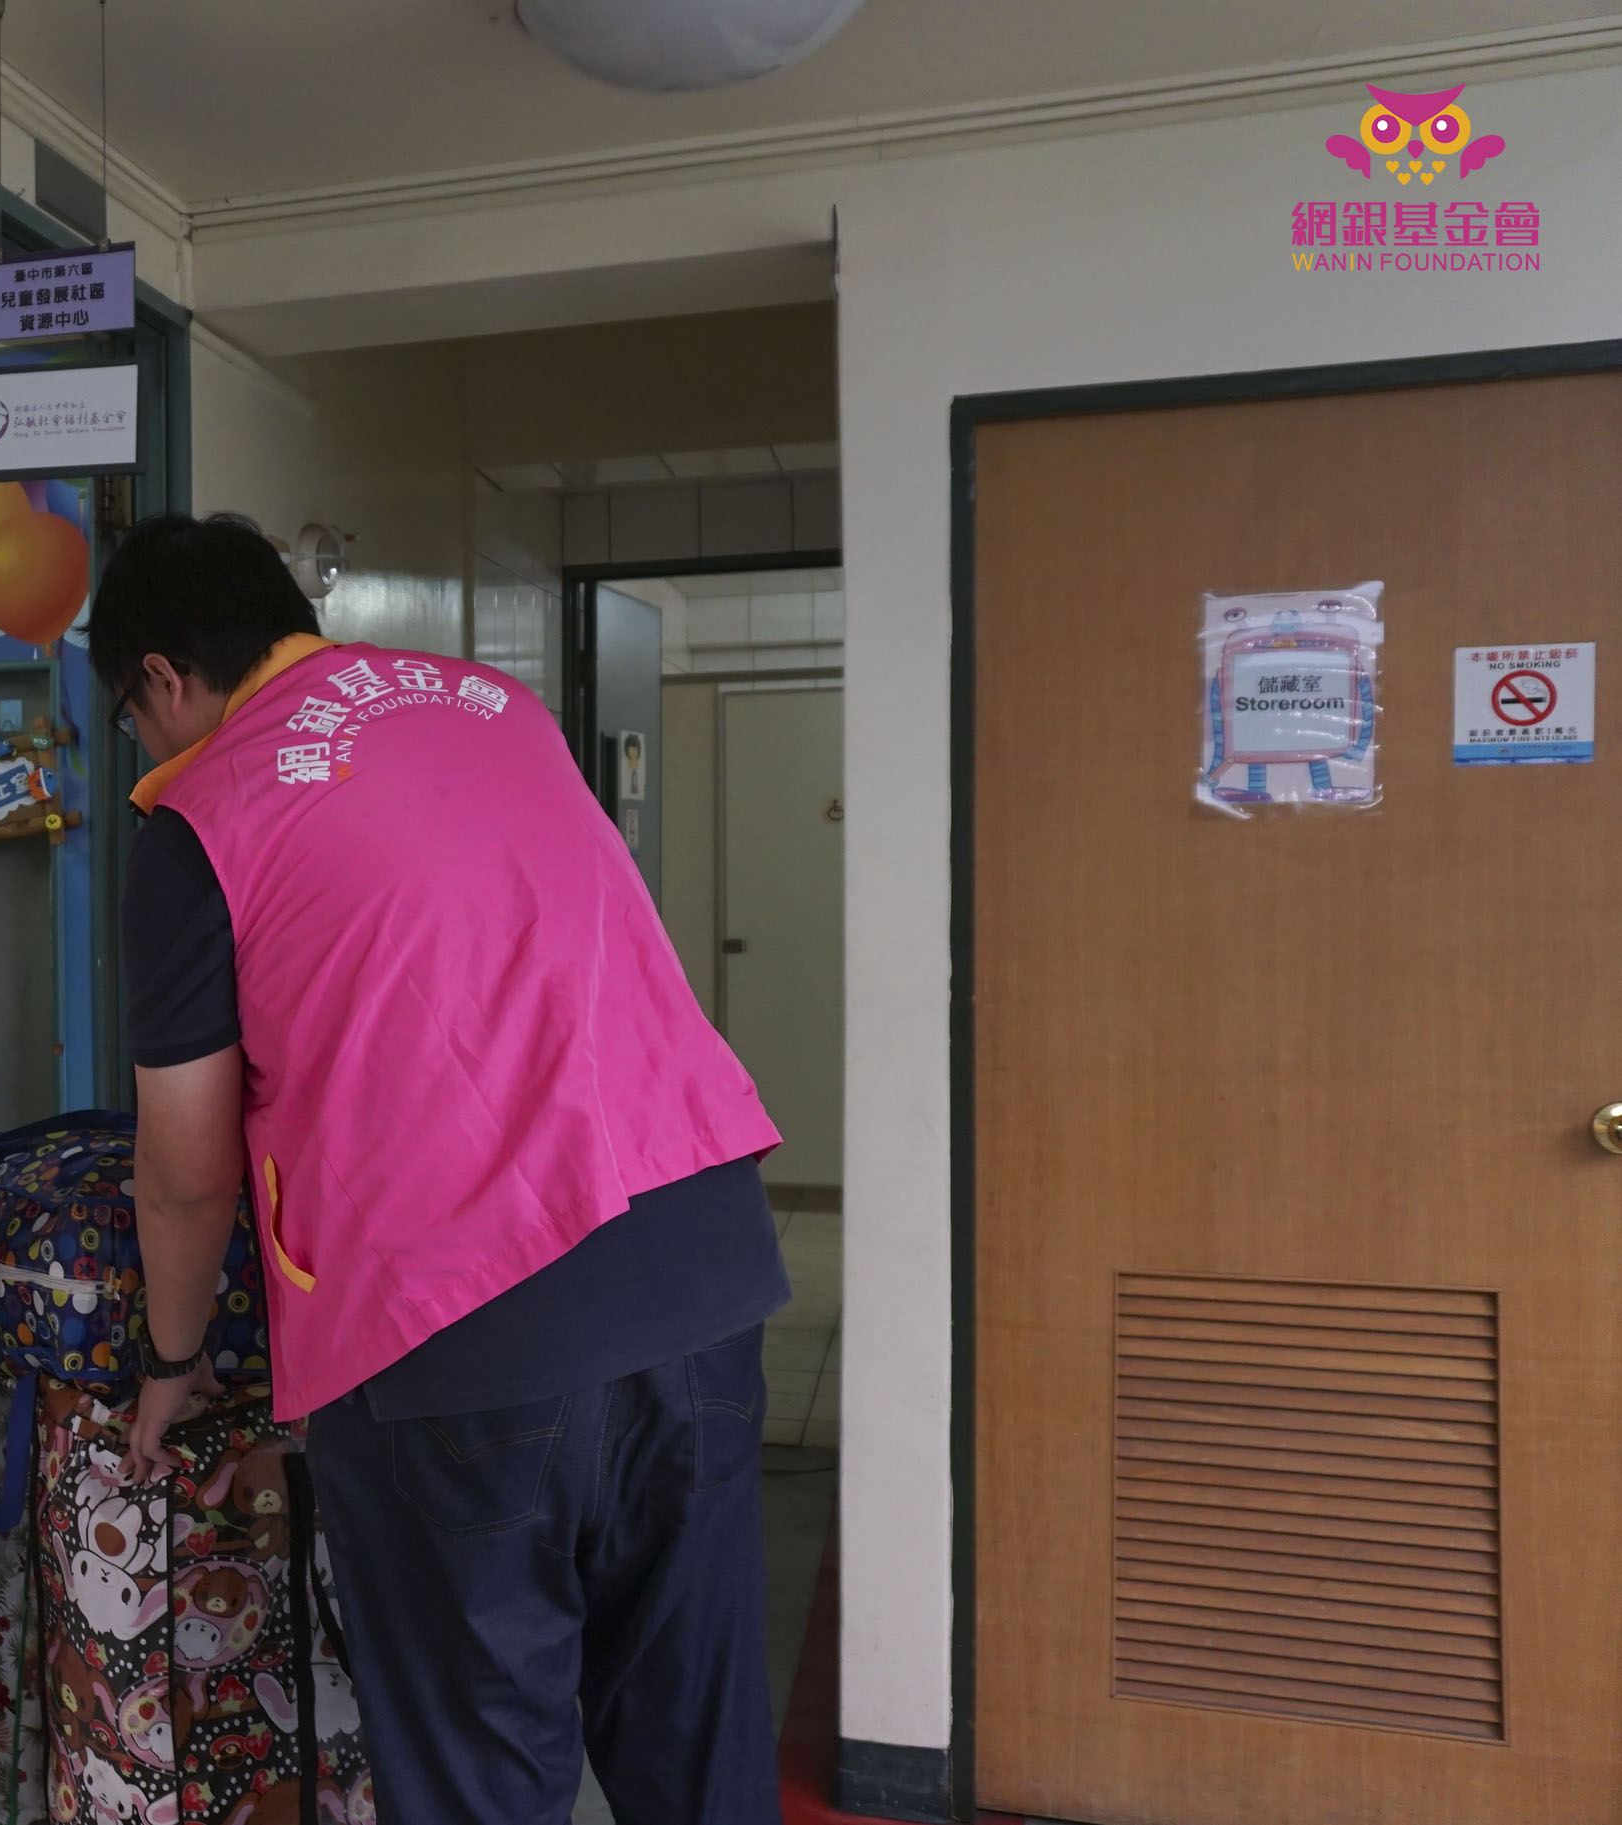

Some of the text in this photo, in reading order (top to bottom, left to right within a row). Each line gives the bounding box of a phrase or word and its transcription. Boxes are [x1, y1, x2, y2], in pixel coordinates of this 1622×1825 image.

[15, 262, 93, 281] 臺中市第六區
[1, 282, 106, 309] 兒童發展社區
[20, 309, 89, 332] 資源中心
[1489, 660, 1561, 670] NO SMOKING
[1258, 675, 1323, 694] 儲藏室
[357, 693, 494, 722] FOUNDATION
[1236, 696, 1345, 712] Storeroom
[277, 658, 510, 785] 網銀基金會
